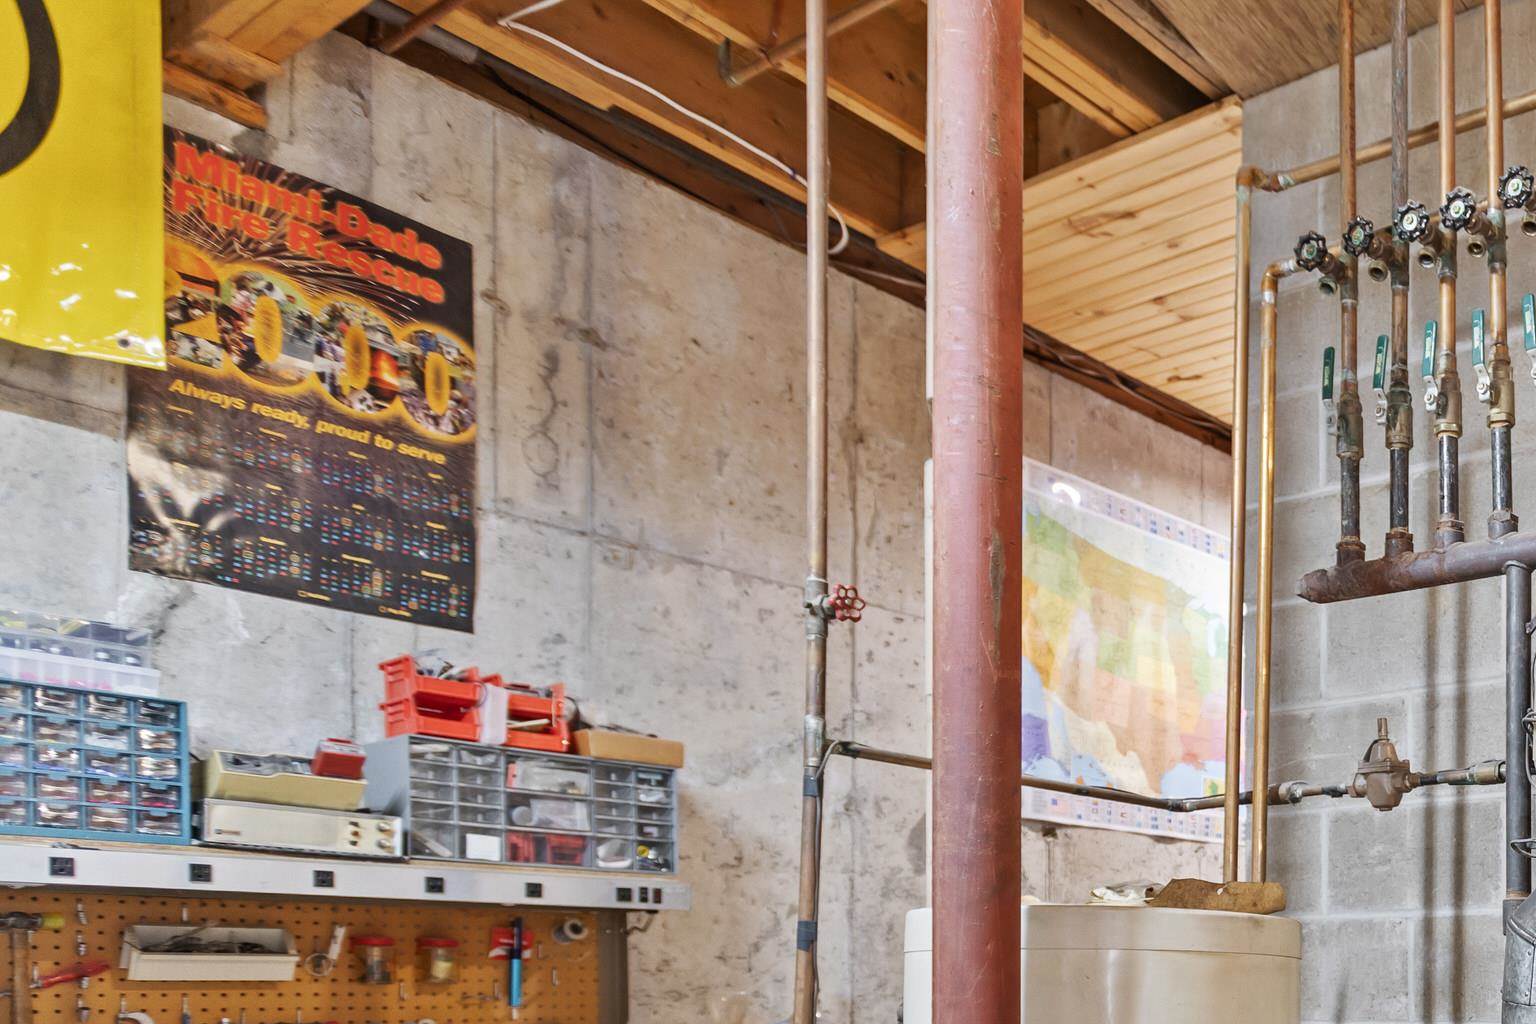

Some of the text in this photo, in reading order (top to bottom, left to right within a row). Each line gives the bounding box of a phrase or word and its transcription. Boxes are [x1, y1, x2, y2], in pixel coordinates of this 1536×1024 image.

[171, 176, 446, 305] Fire Rescue
[173, 139, 444, 271] Miami-Dade
[168, 377, 247, 411] Always
[250, 400, 311, 430] ready,
[314, 416, 371, 446] proud
[373, 432, 395, 452] to
[396, 441, 448, 465] serve
